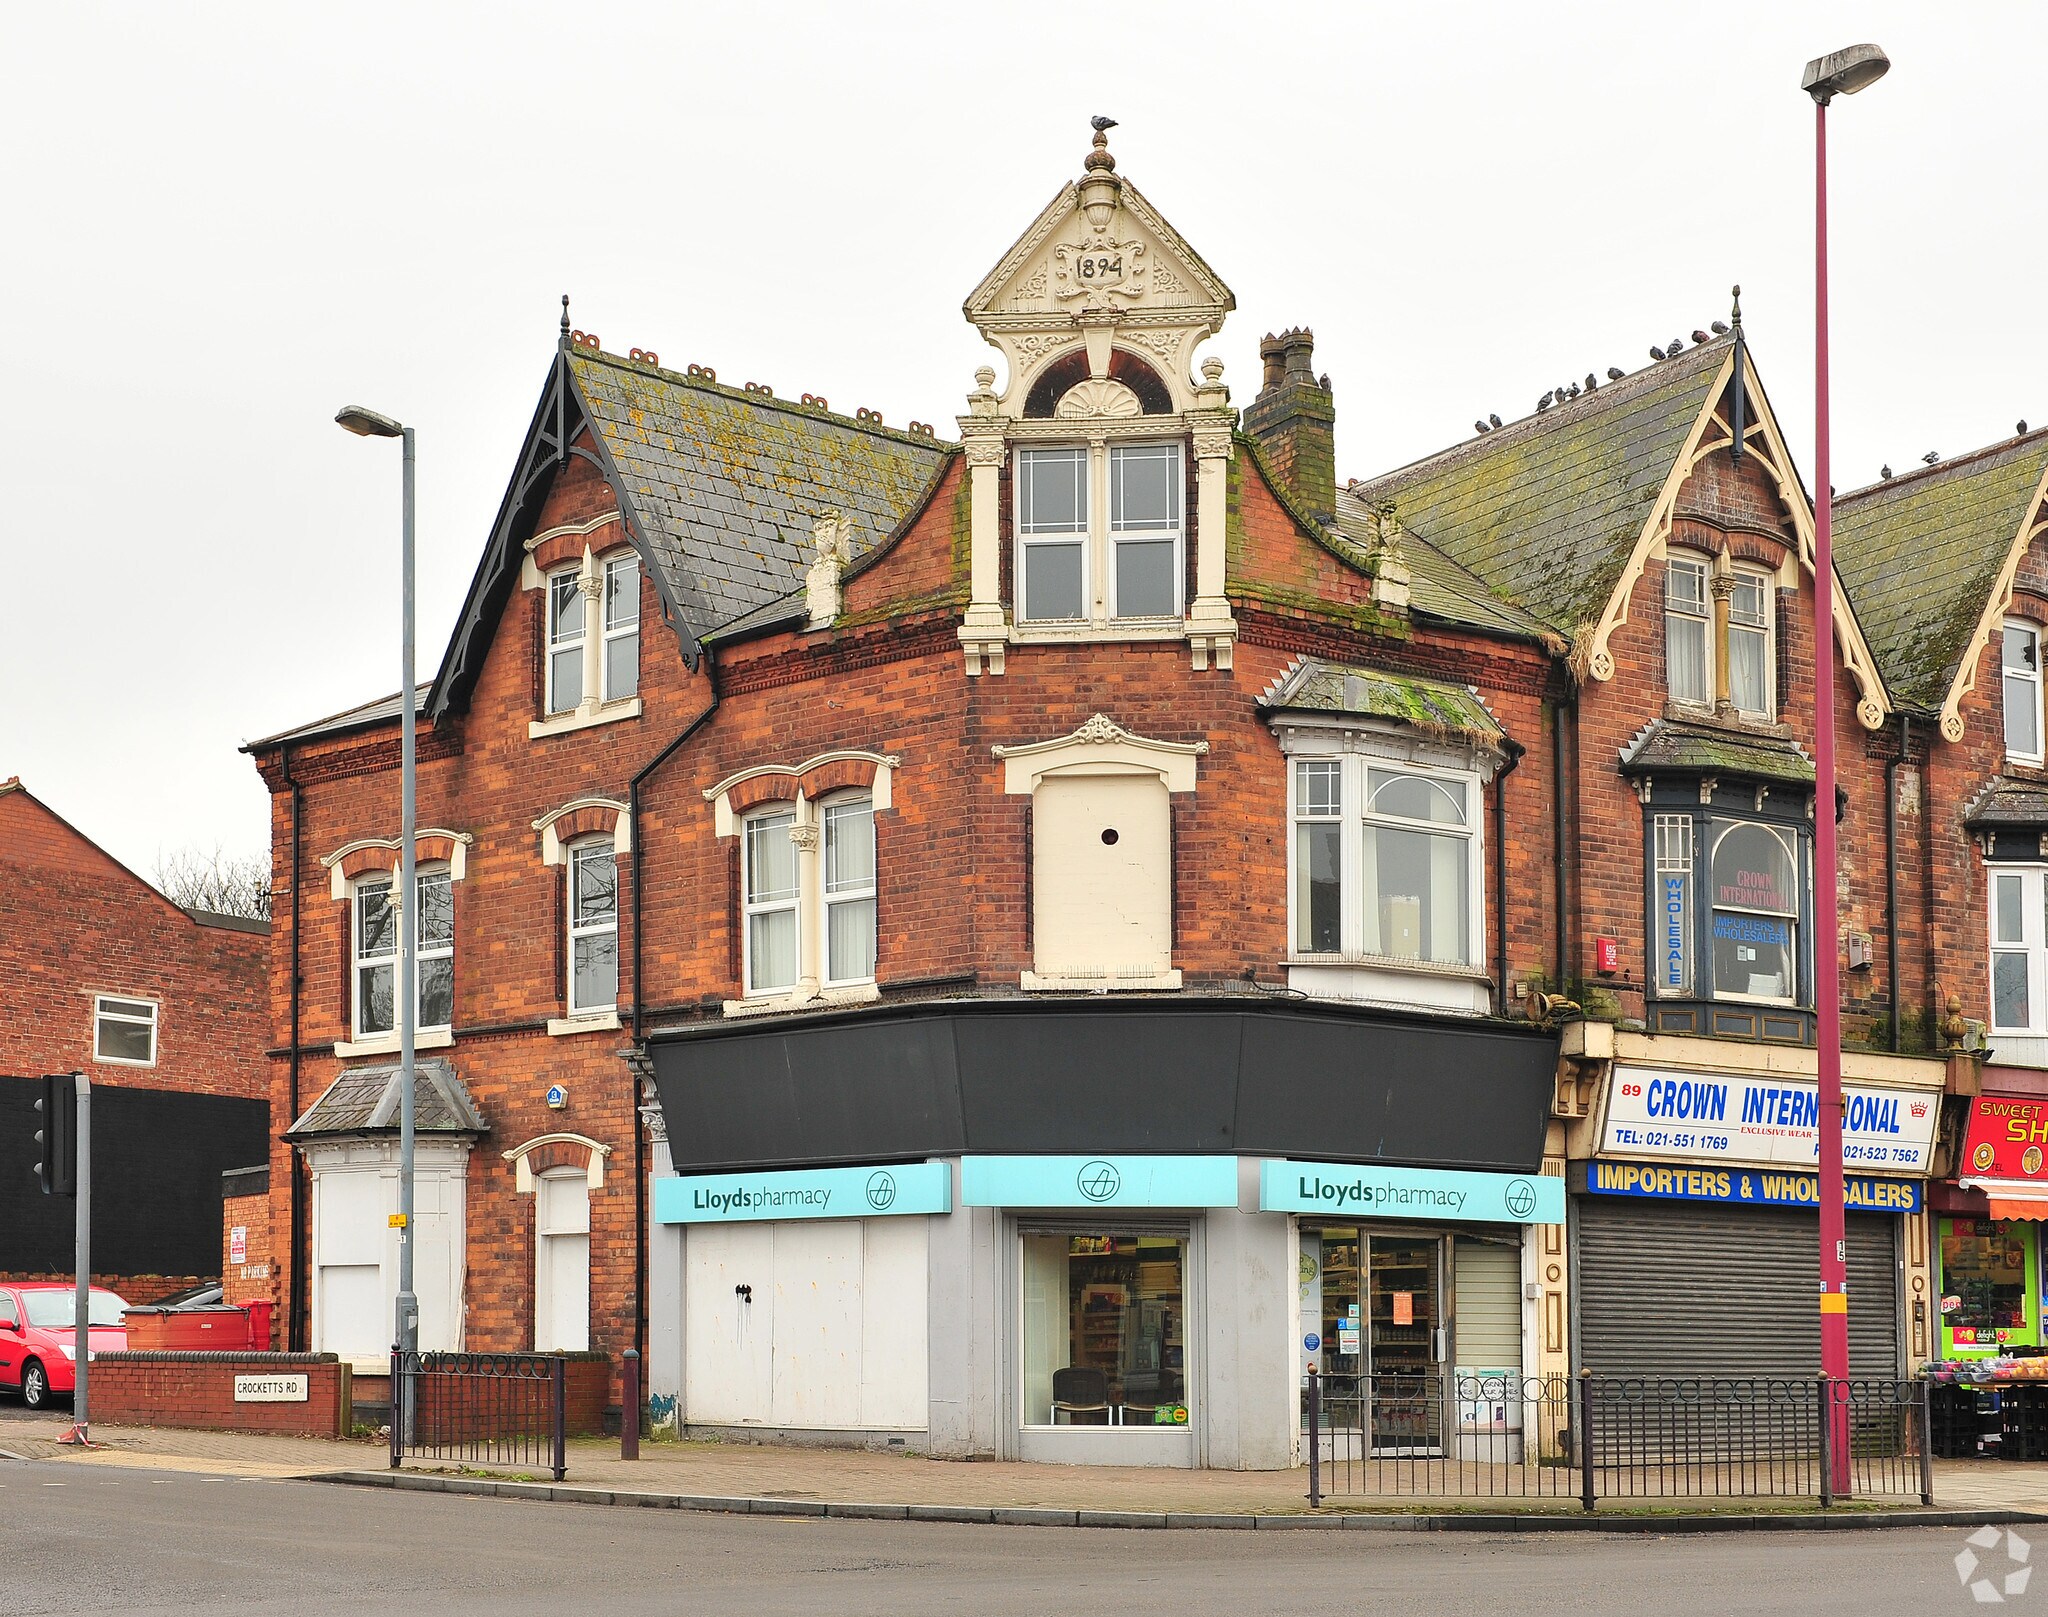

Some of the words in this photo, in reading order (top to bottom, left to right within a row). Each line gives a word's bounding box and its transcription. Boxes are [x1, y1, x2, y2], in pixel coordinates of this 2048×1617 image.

[1076, 255, 1123, 279] 1894
[1737, 870, 1773, 889] CROWN
[1664, 878, 1684, 985] WHOLESALE
[1715, 915, 1775, 933] IMPORTERS
[1713, 926, 1790, 945] WHOLESALERS
[1621, 1083, 1642, 1097] 89
[1646, 1078, 1728, 1121] CROWN
[1741, 1086, 1900, 1134] INTERNIONAL
[1980, 1102, 2043, 1119] SWEET
[1615, 1128, 1644, 1145] TEL:
[1700, 1135, 1728, 1150] 1769
[1740, 1126, 1786, 1137] EXCLUSIVE
[1787, 1129, 1813, 1139] WEAR
[1892, 1148, 1919, 1163] 7562
[1597, 1163, 1731, 1198] IMPORTERS
[1740, 1175, 1754, 1199] &
[237, 1382, 284, 1395] CROCKETTS
[286, 1381, 298, 1394] RD
